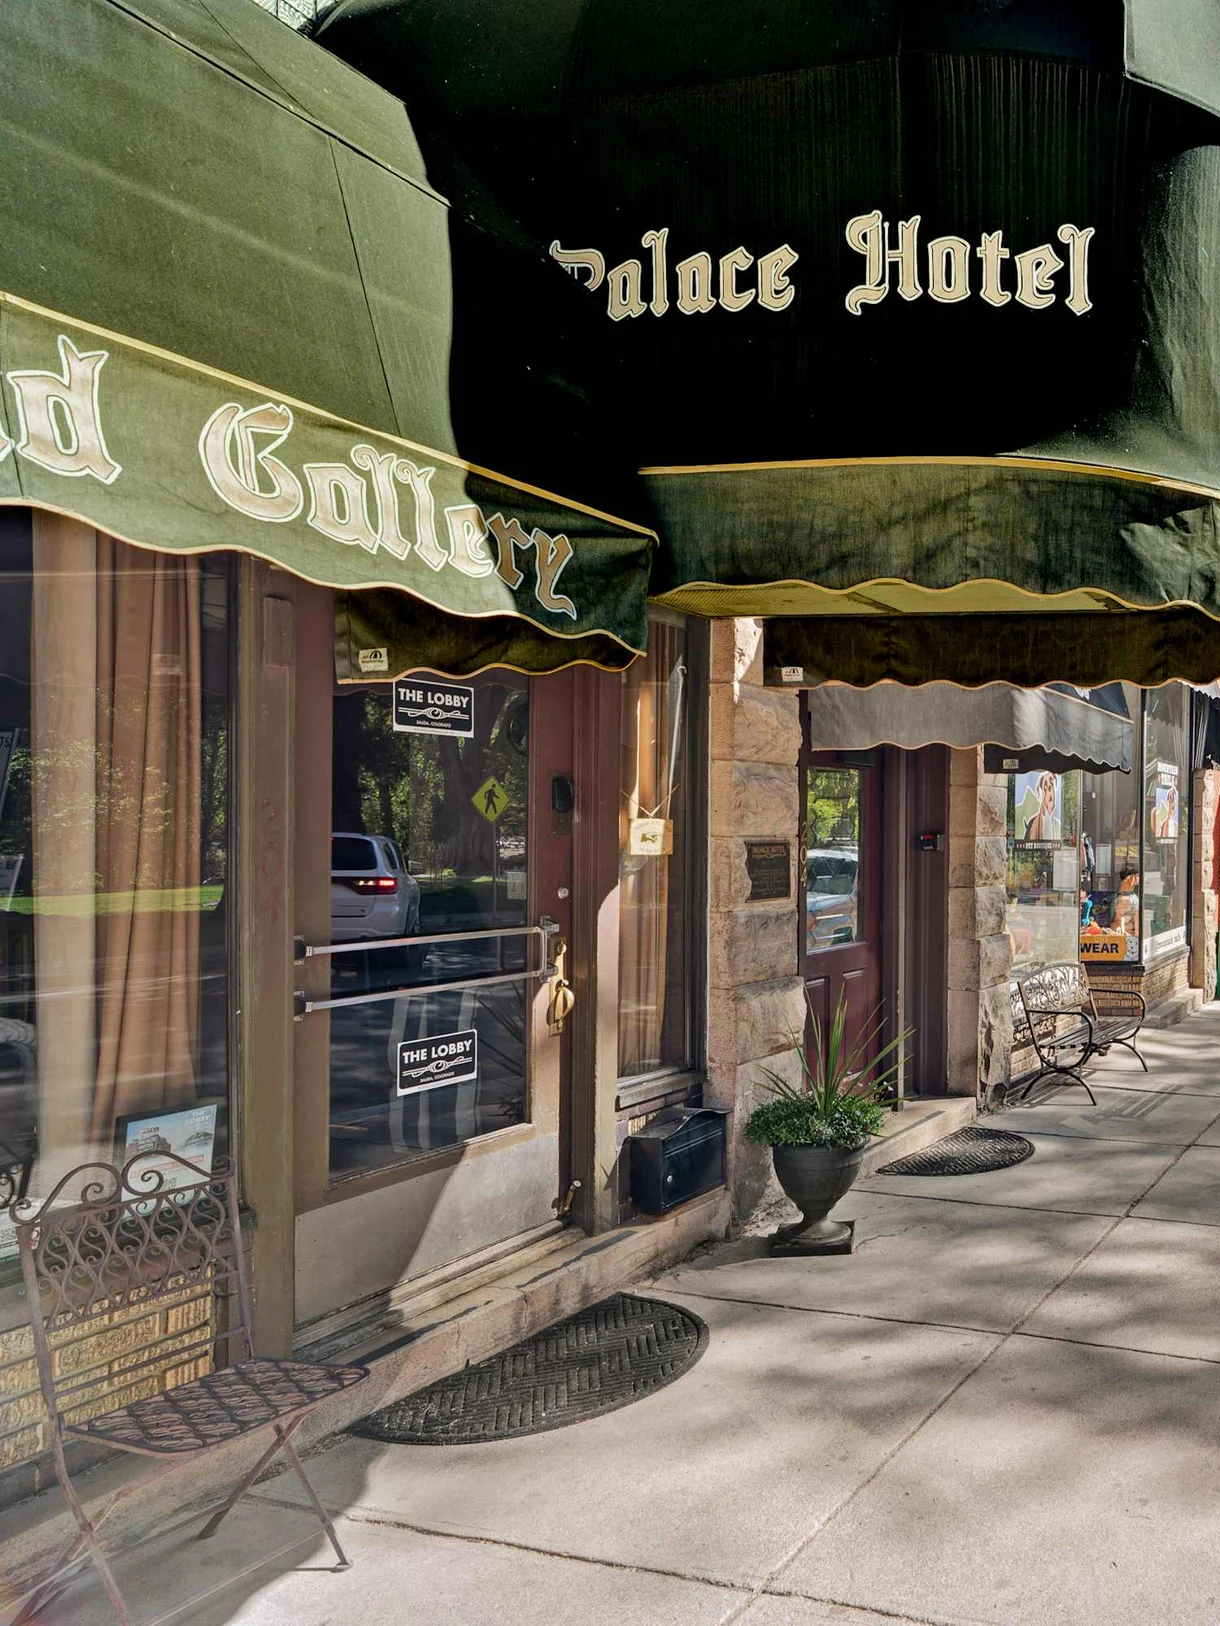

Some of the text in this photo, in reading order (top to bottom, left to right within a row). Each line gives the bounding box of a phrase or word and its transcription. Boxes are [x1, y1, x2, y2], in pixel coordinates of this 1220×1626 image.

[845, 209, 1096, 317] Hotel
[0, 334, 578, 621] d Gallery
[397, 688, 470, 709] THE LOBBY
[1080, 942, 1120, 954] WEAR
[402, 1039, 473, 1064] THE LOBBY
